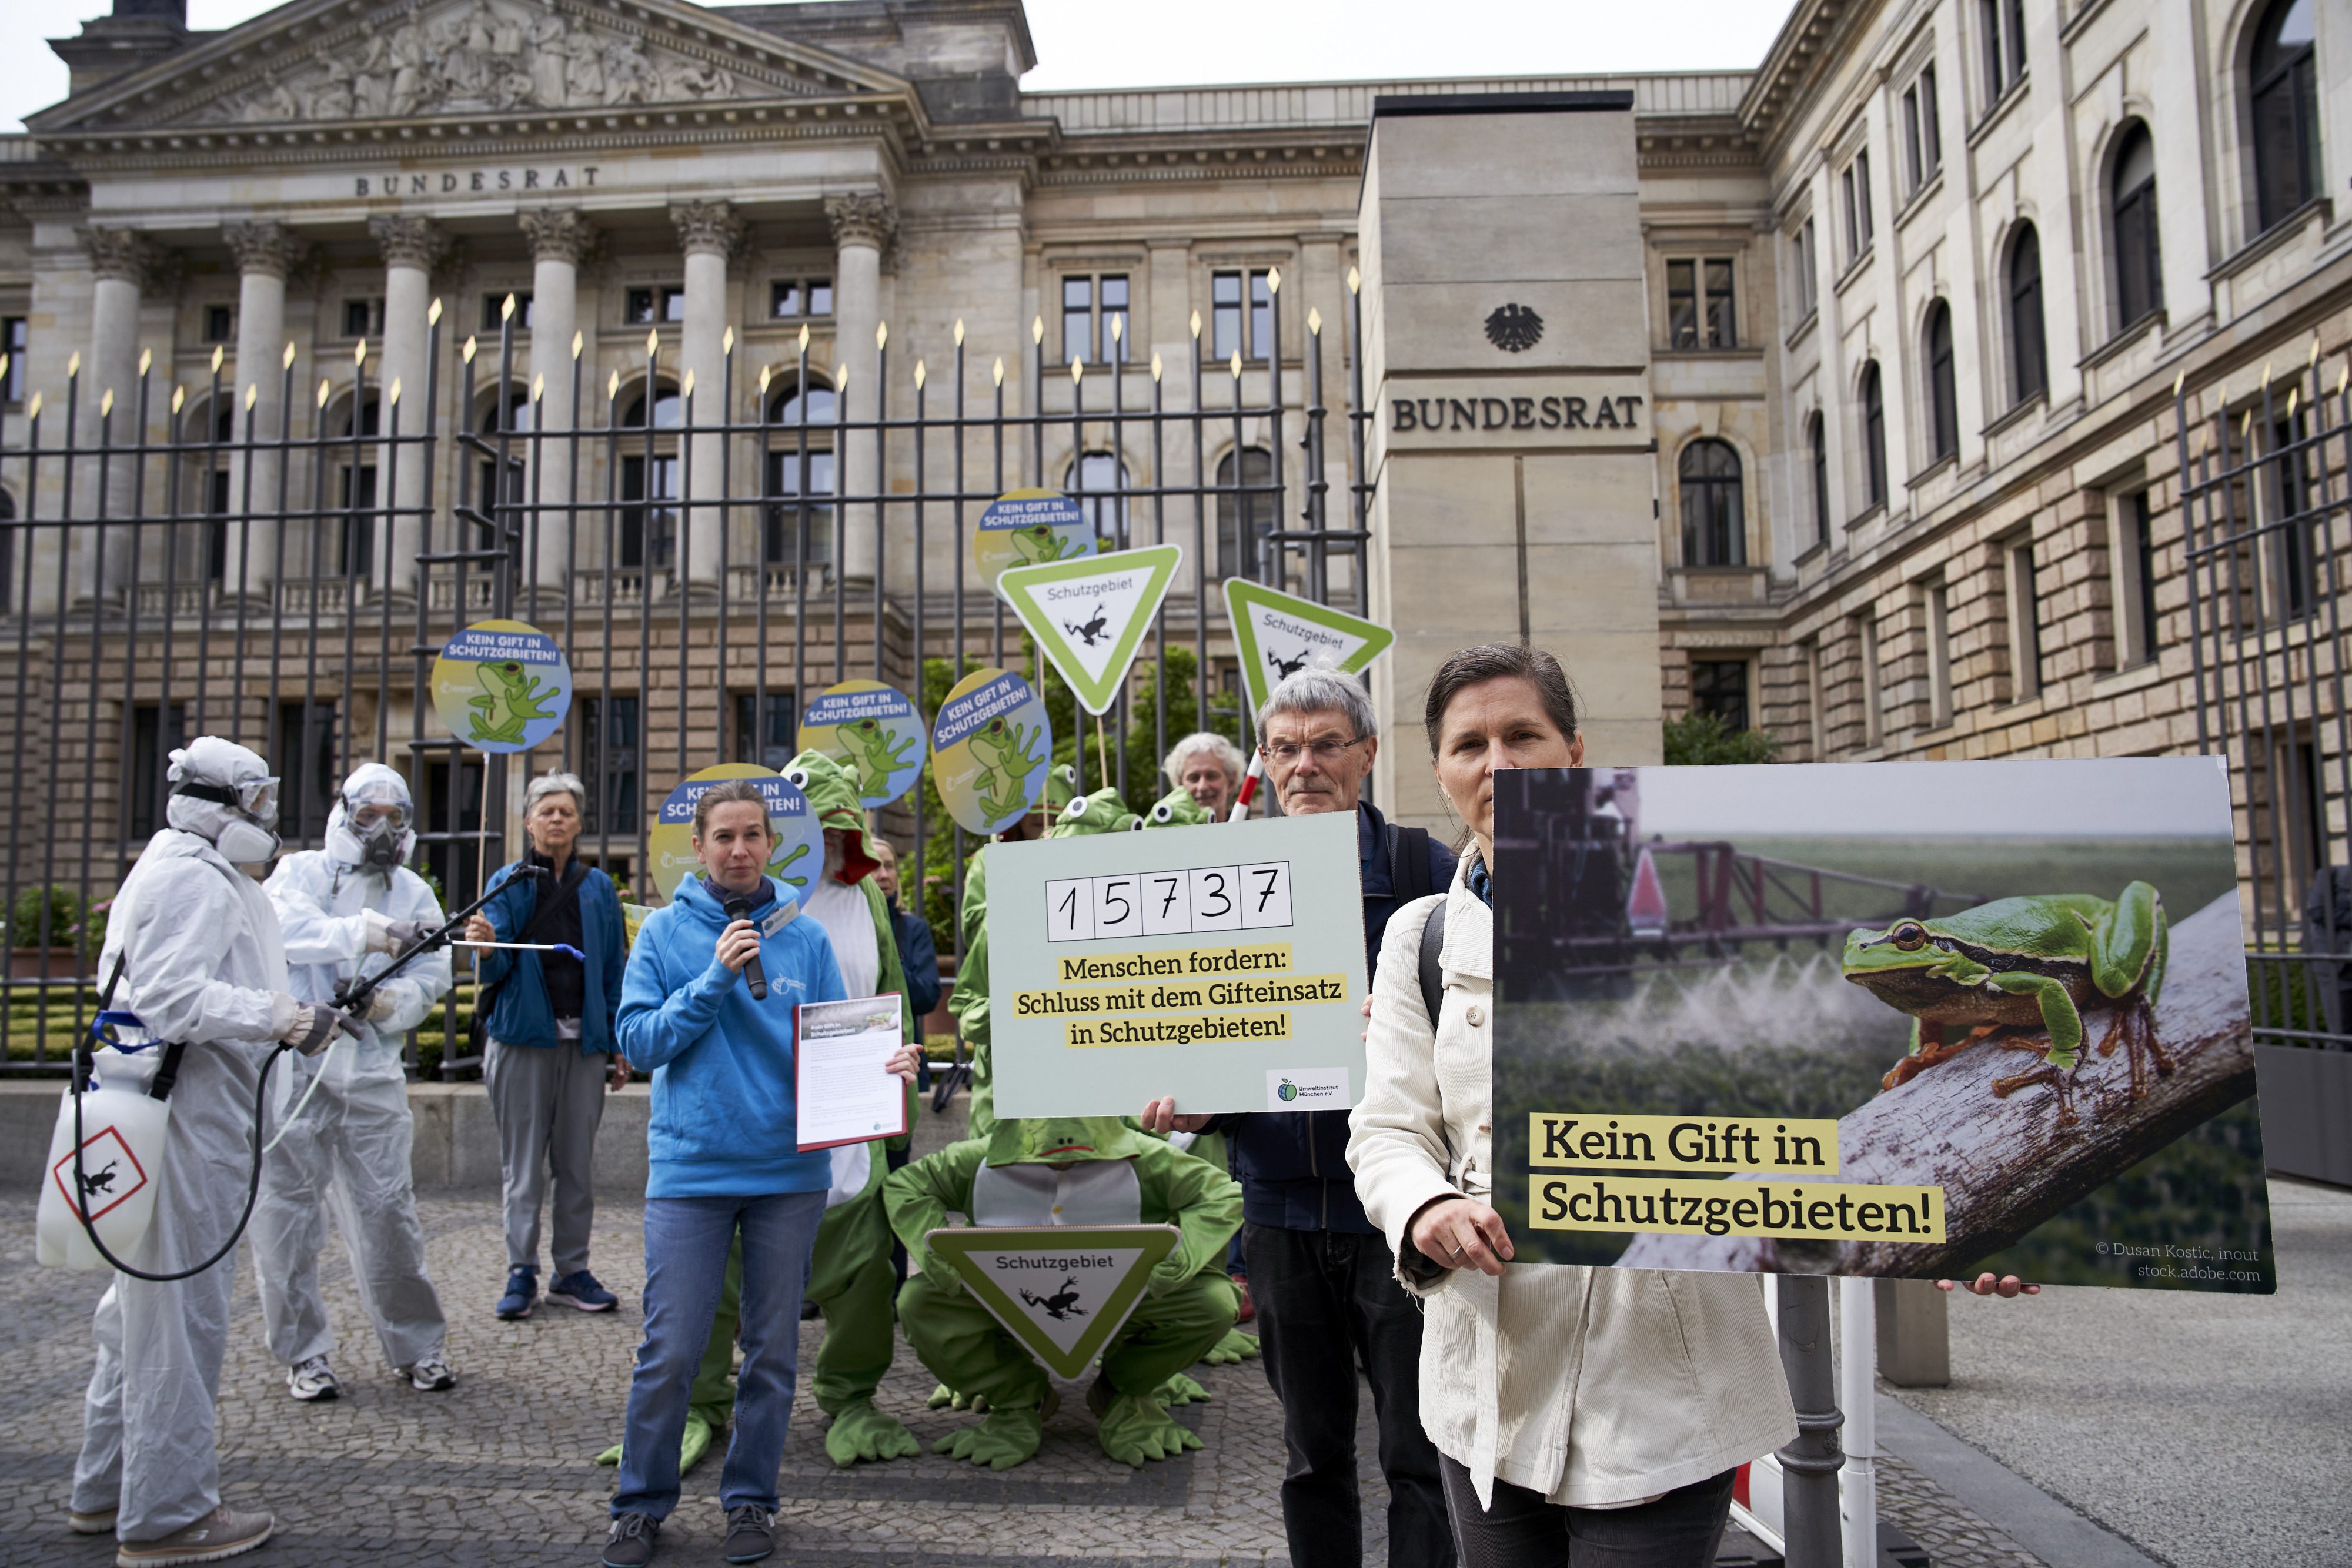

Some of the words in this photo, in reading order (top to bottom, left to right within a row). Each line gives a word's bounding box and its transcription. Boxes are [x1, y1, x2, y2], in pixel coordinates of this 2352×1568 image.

[356, 167, 599, 196] BUNDESRAT
[1392, 396, 1643, 432] BUNDESRAT
[984, 511, 1079, 526] SCHUTZGEBIETEN!
[998, 503, 1023, 514] KEIN
[1025, 502, 1048, 513] GIFT
[1052, 501, 1064, 511] IN
[1047, 578, 1133, 601] Schutzgebiet
[466, 634, 495, 646] KEIN
[498, 636, 524, 647] GIFT
[527, 638, 540, 648] IN
[1263, 614, 1344, 650] Schutzgebiet
[449, 644, 556, 661] SCHUTZGEBIETEN!
[823, 697, 848, 709] KEIN
[851, 694, 876, 706] GIFT
[878, 693, 891, 704] IN
[947, 699, 974, 721] KEIN
[974, 686, 997, 707] GIFT
[998, 679, 1011, 695] IN
[808, 703, 907, 722] SCHUTZGEBIETEN!
[937, 686, 1028, 743] SCHUTZGEBIETEN!
[763, 783, 779, 797] IN
[1063, 955, 1183, 980] Menschen
[1189, 948, 1287, 974] fordern:
[1017, 991, 1100, 1015] Schluss
[1105, 989, 1146, 1011] mit
[1151, 987, 1202, 1008] dem
[1208, 979, 1342, 1006] Gifteinsatz
[1070, 1024, 1094, 1045] in
[1100, 1014, 1287, 1045] Schutzgebieten!
[1542, 1119, 1655, 1161] Kein
[1668, 1122, 1761, 1164] Gift
[1773, 1124, 1825, 1166] in
[1542, 1181, 1932, 1236] Schutzgebieten!
[996, 1255, 1115, 1271] Schutzgebiet
[2113, 1242, 2160, 1256] Dusan
[2165, 1245, 2214, 1261] Kostic,
[2219, 1246, 2259, 1261] inout
[2137, 1265, 2261, 1282] stock.adobe.com
